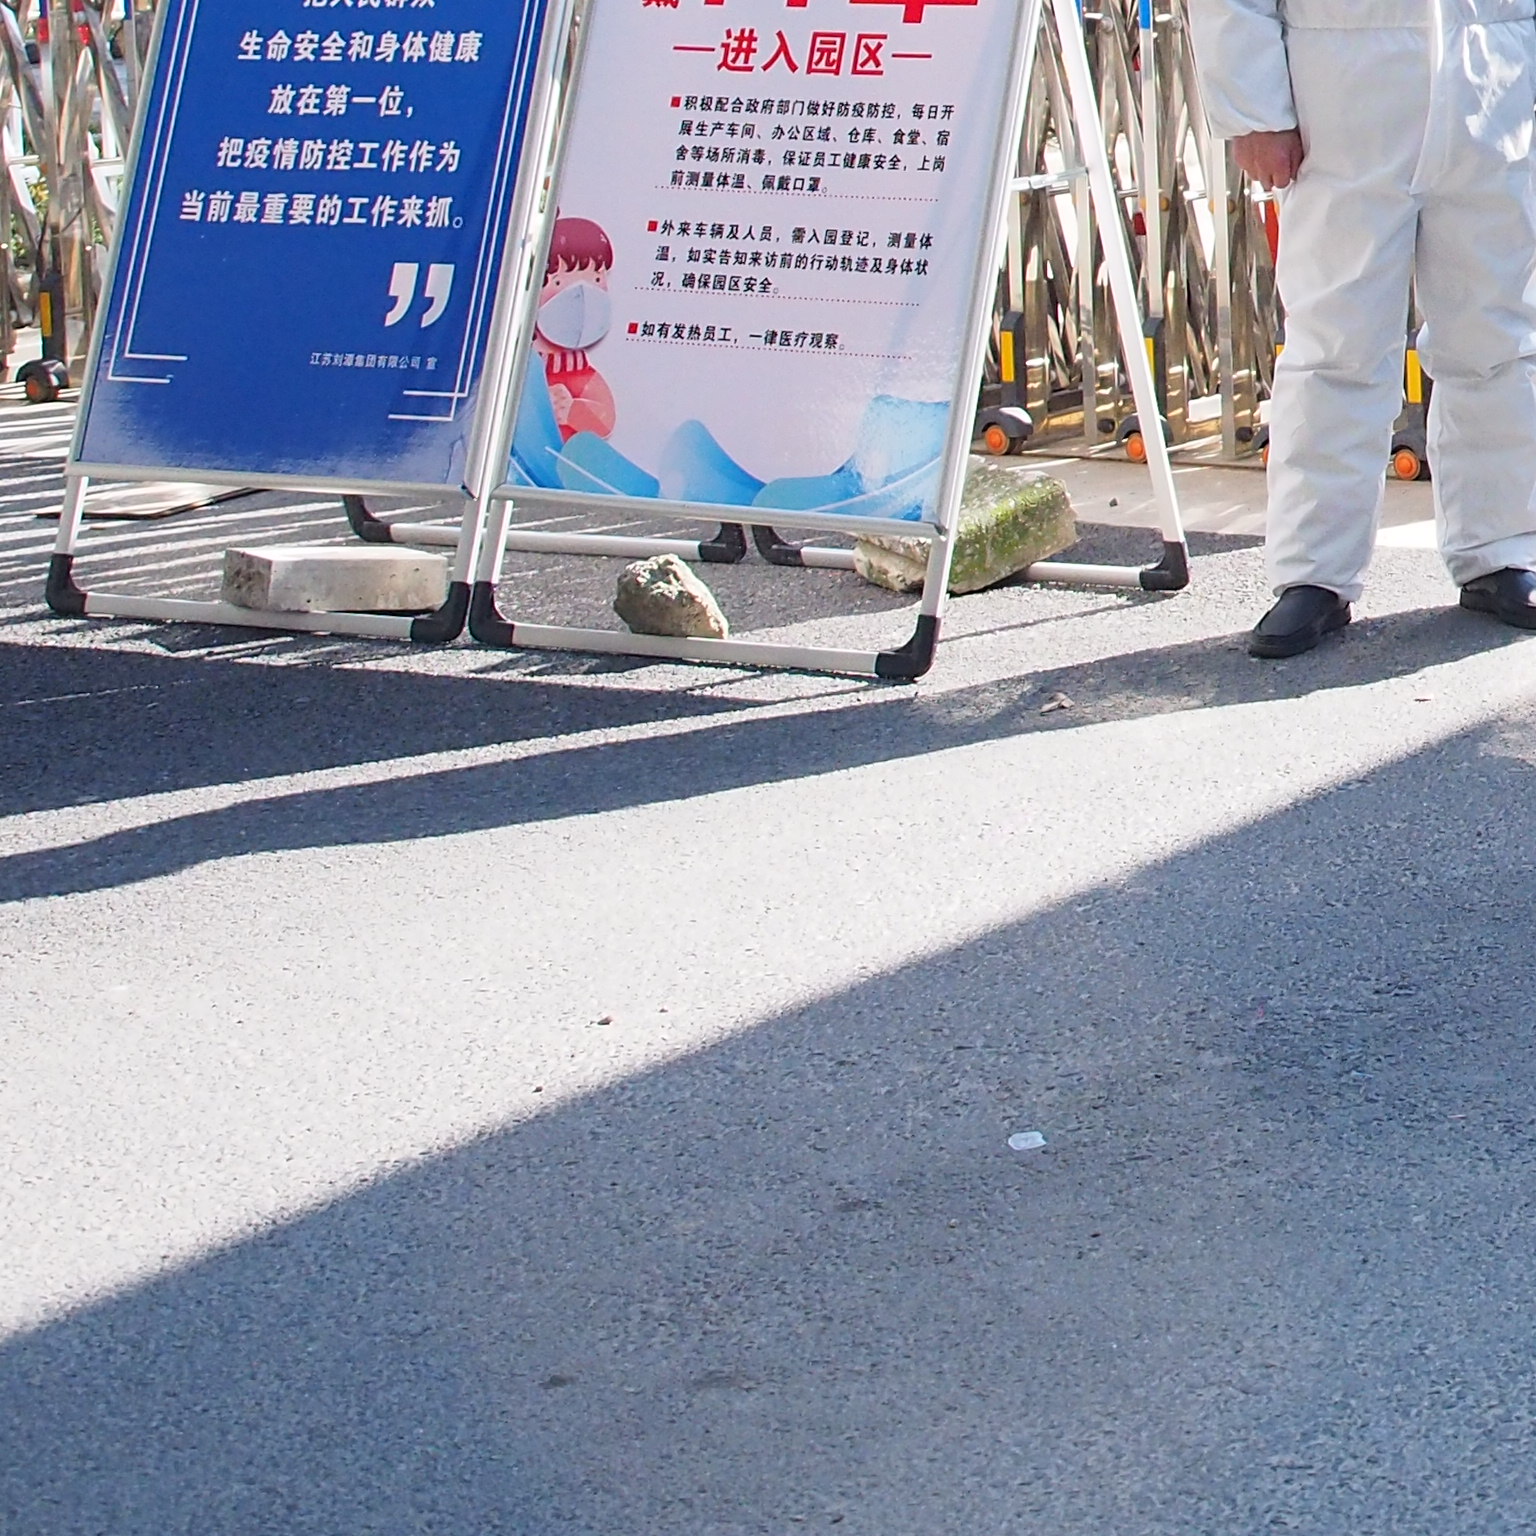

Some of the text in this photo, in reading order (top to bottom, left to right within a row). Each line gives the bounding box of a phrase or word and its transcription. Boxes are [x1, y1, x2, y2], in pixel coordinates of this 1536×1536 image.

[237, 30, 483, 63] 生命安全和身体健康
[716, 29, 890, 77] 进入园区
[216, 137, 461, 173] 把疫情防控工作作为
